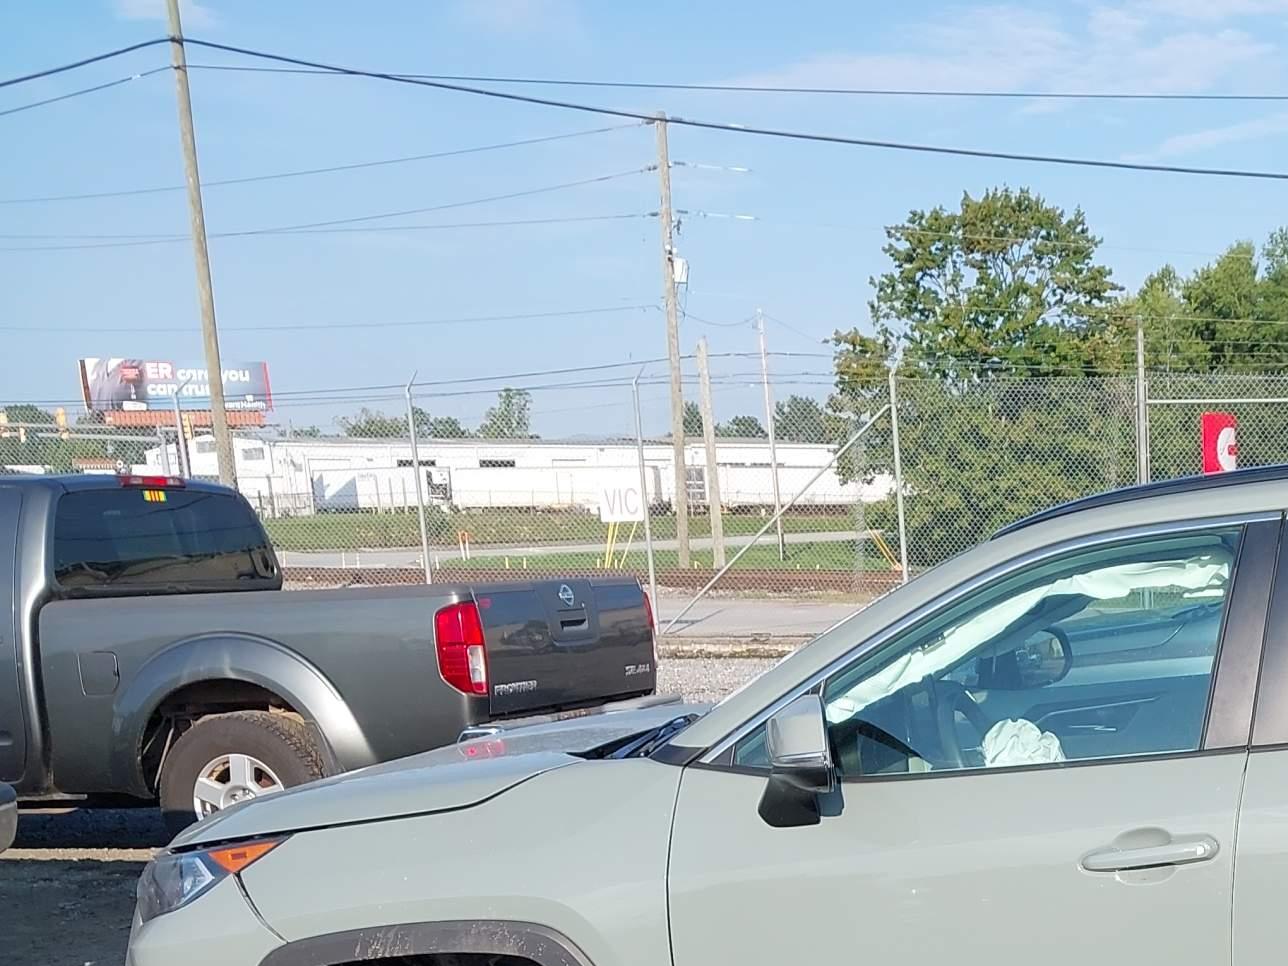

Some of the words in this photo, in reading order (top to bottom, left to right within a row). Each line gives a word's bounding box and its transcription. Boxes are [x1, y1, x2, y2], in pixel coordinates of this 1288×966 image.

[145, 362, 173, 379] ER
[147, 383, 178, 396] can
[603, 487, 639, 516] VIC
[494, 679, 537, 696] FRONTIER
